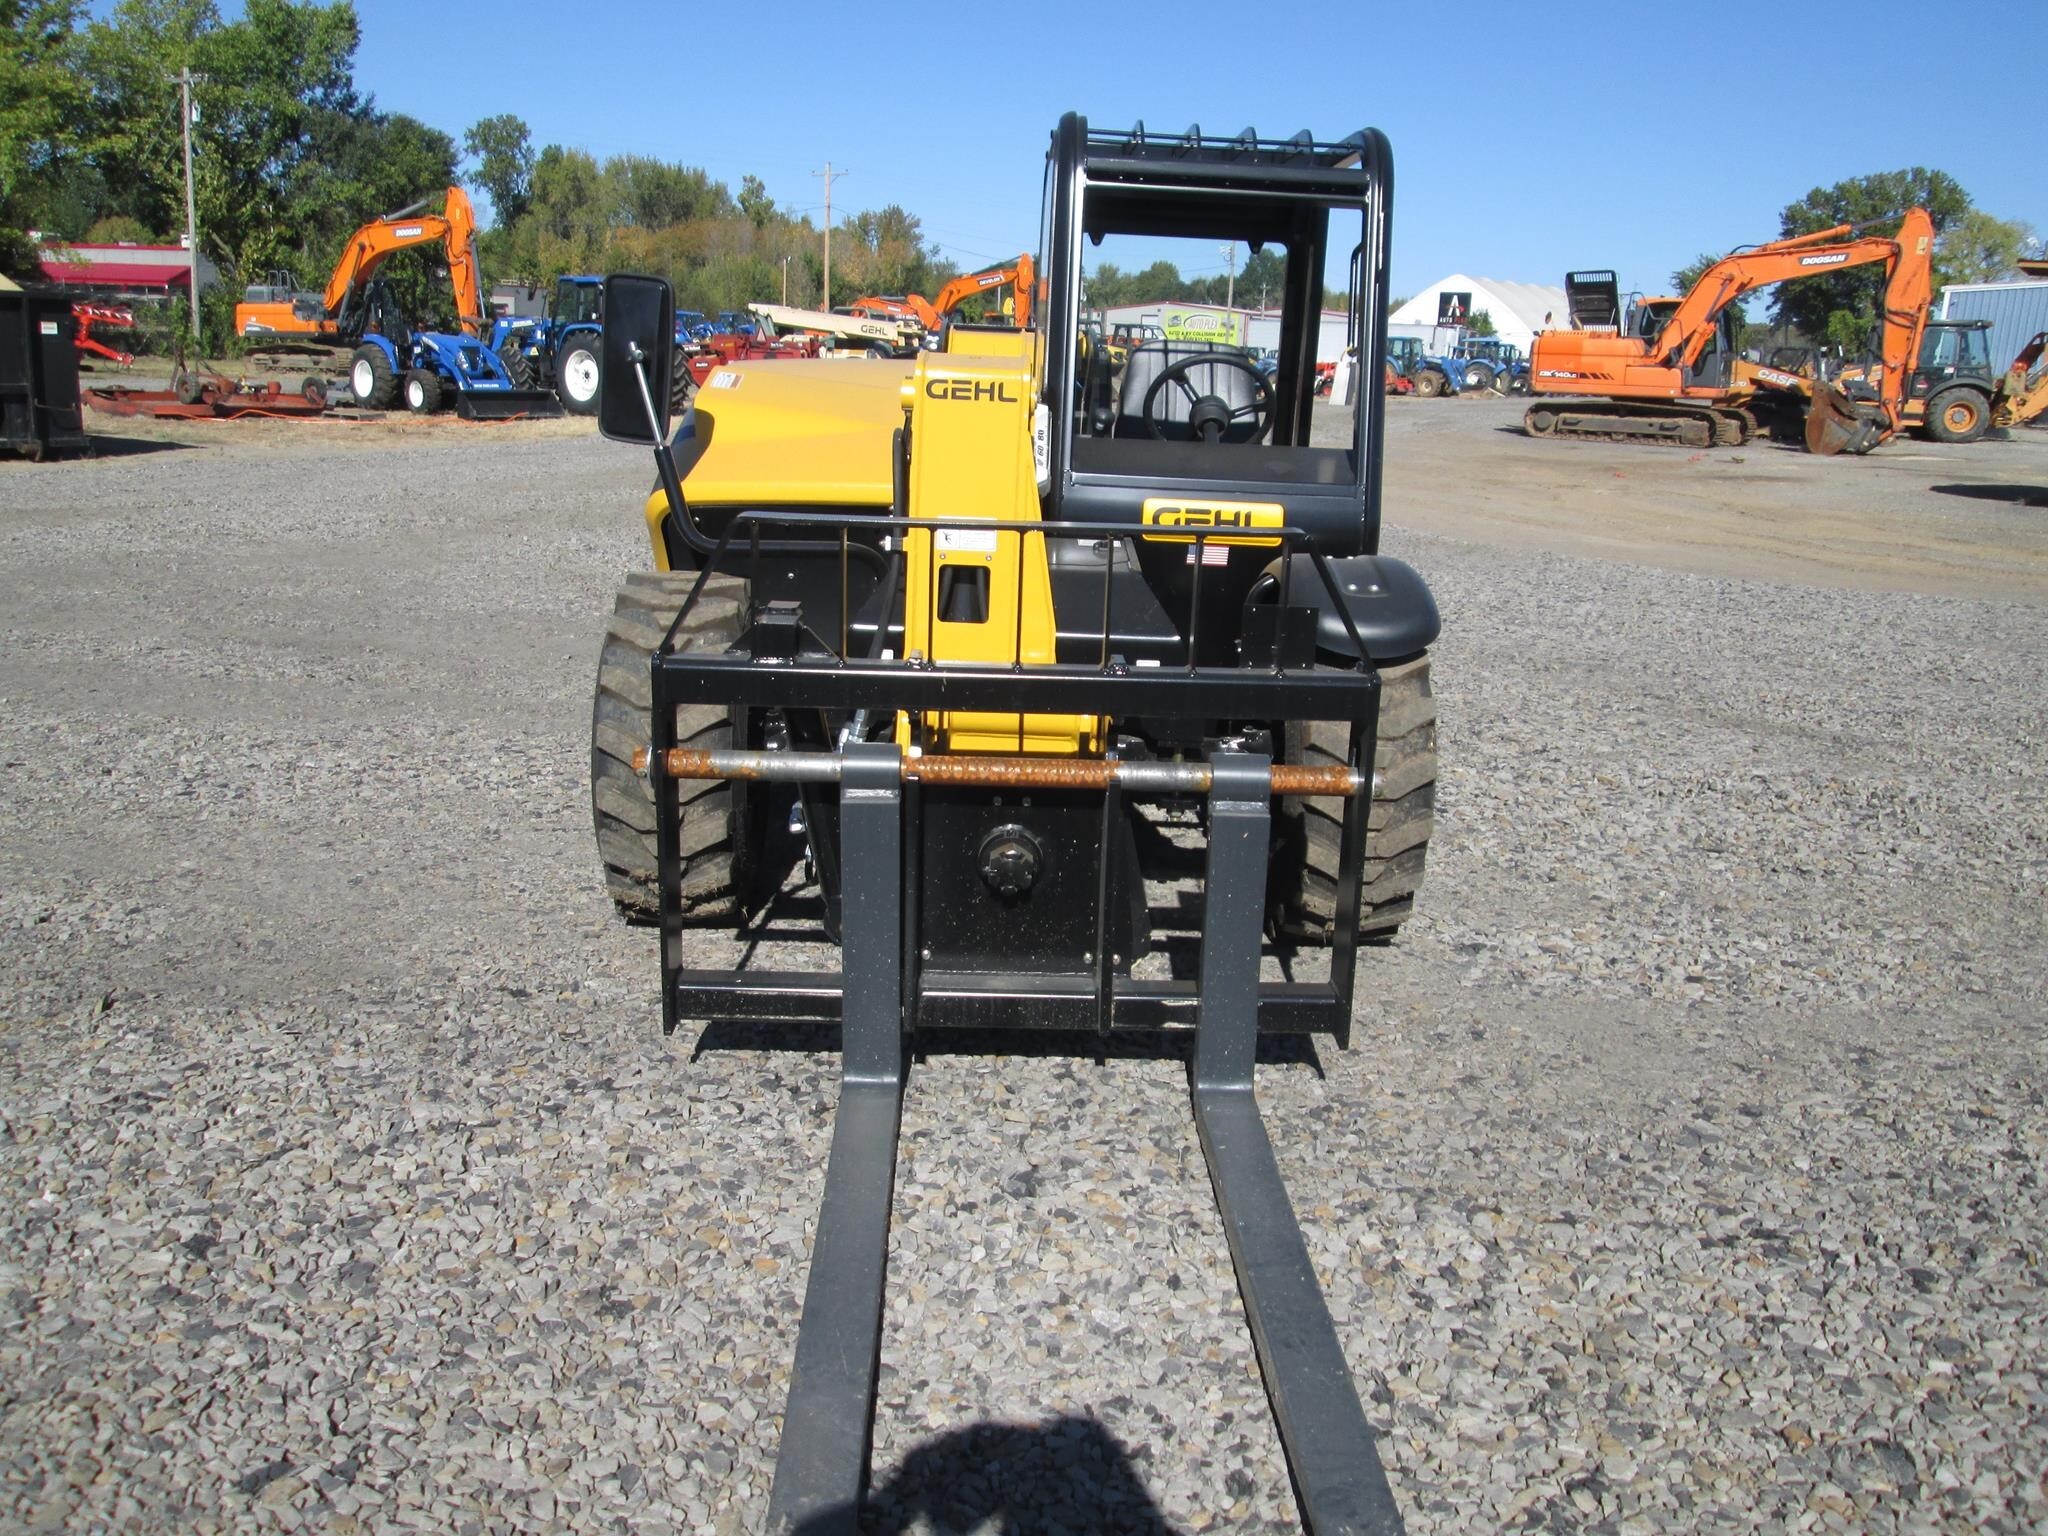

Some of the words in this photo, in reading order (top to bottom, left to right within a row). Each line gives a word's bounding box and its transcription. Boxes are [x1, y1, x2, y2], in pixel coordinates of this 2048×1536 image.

[1801, 254, 1846, 265] DOOSAN
[860, 324, 888, 336] GEHL
[925, 379, 1018, 403] GEHL
